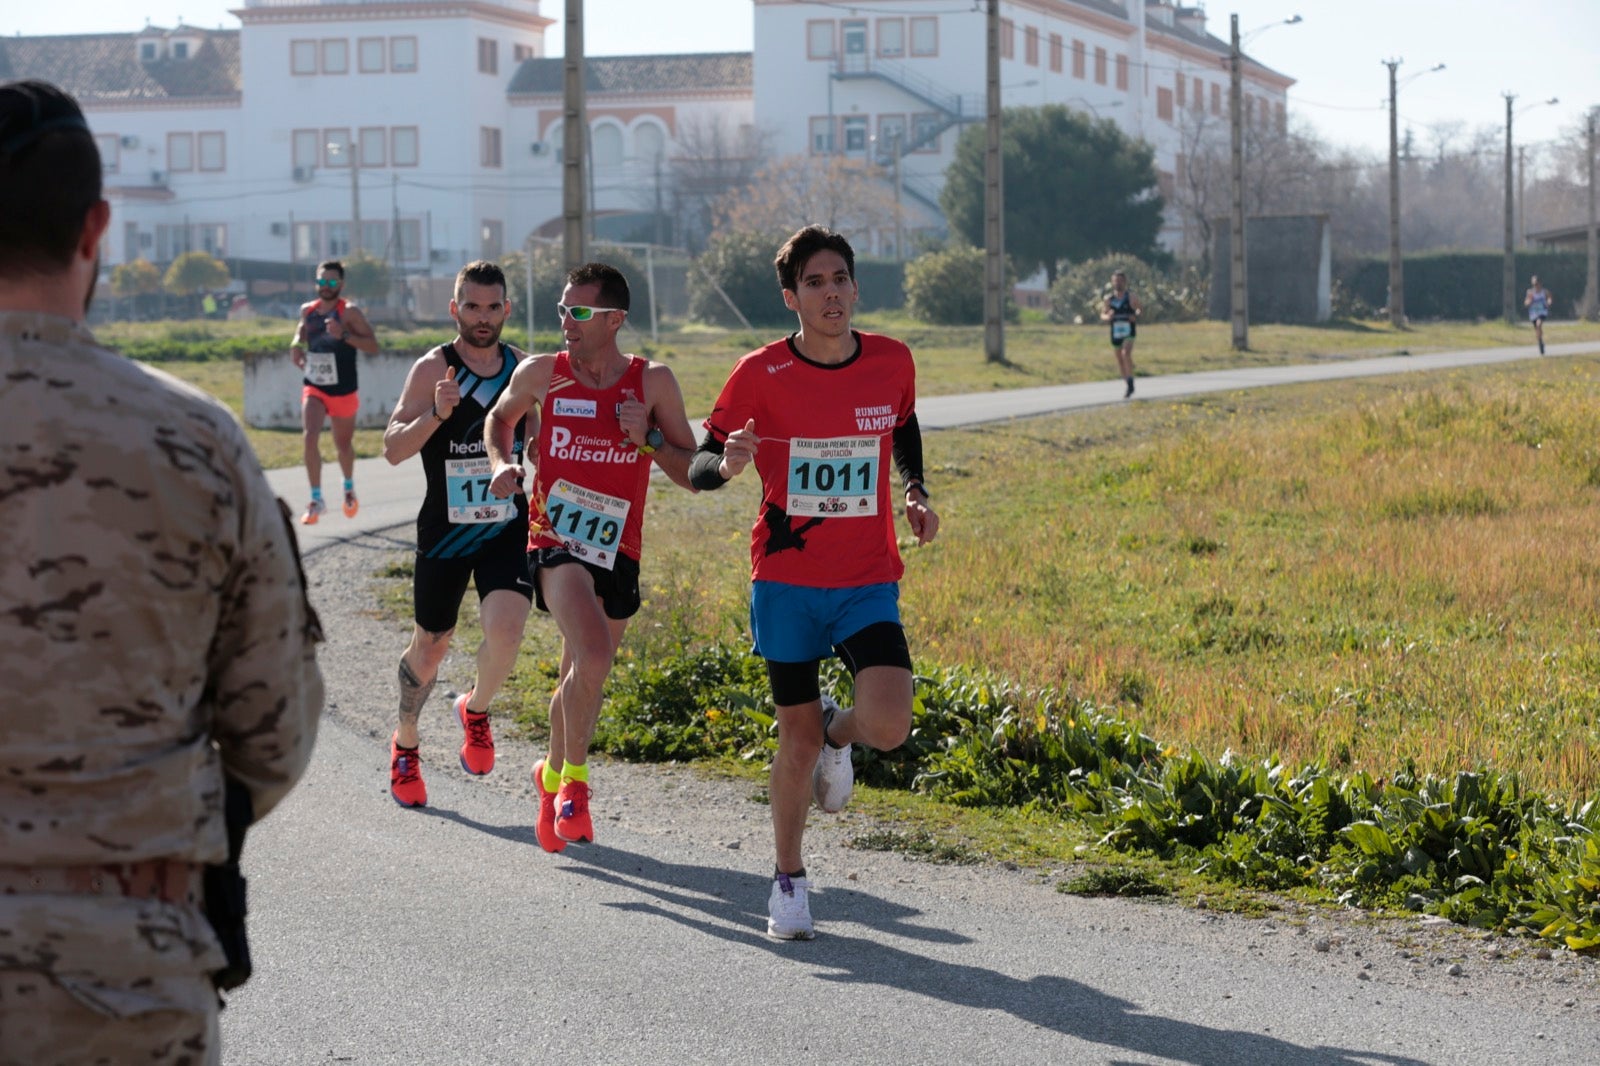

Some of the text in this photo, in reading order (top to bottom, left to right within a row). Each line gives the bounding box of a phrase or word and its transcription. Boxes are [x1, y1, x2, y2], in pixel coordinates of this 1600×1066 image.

[855, 404, 892, 417] RUNNING
[856, 413, 898, 431] VAMPIR
[450, 439, 487, 454] healt
[549, 426, 639, 464] Polisalud
[575, 435, 612, 447] Clínicas
[814, 440, 828, 449] GRAN
[829, 440, 850, 448] PREMIO
[850, 440, 857, 448] DE
[858, 439, 876, 448] FONDO
[820, 449, 853, 458] DIPUTACIÓN
[795, 462, 870, 491] 1011
[461, 478, 509, 502] 17
[549, 503, 619, 546] 1119
